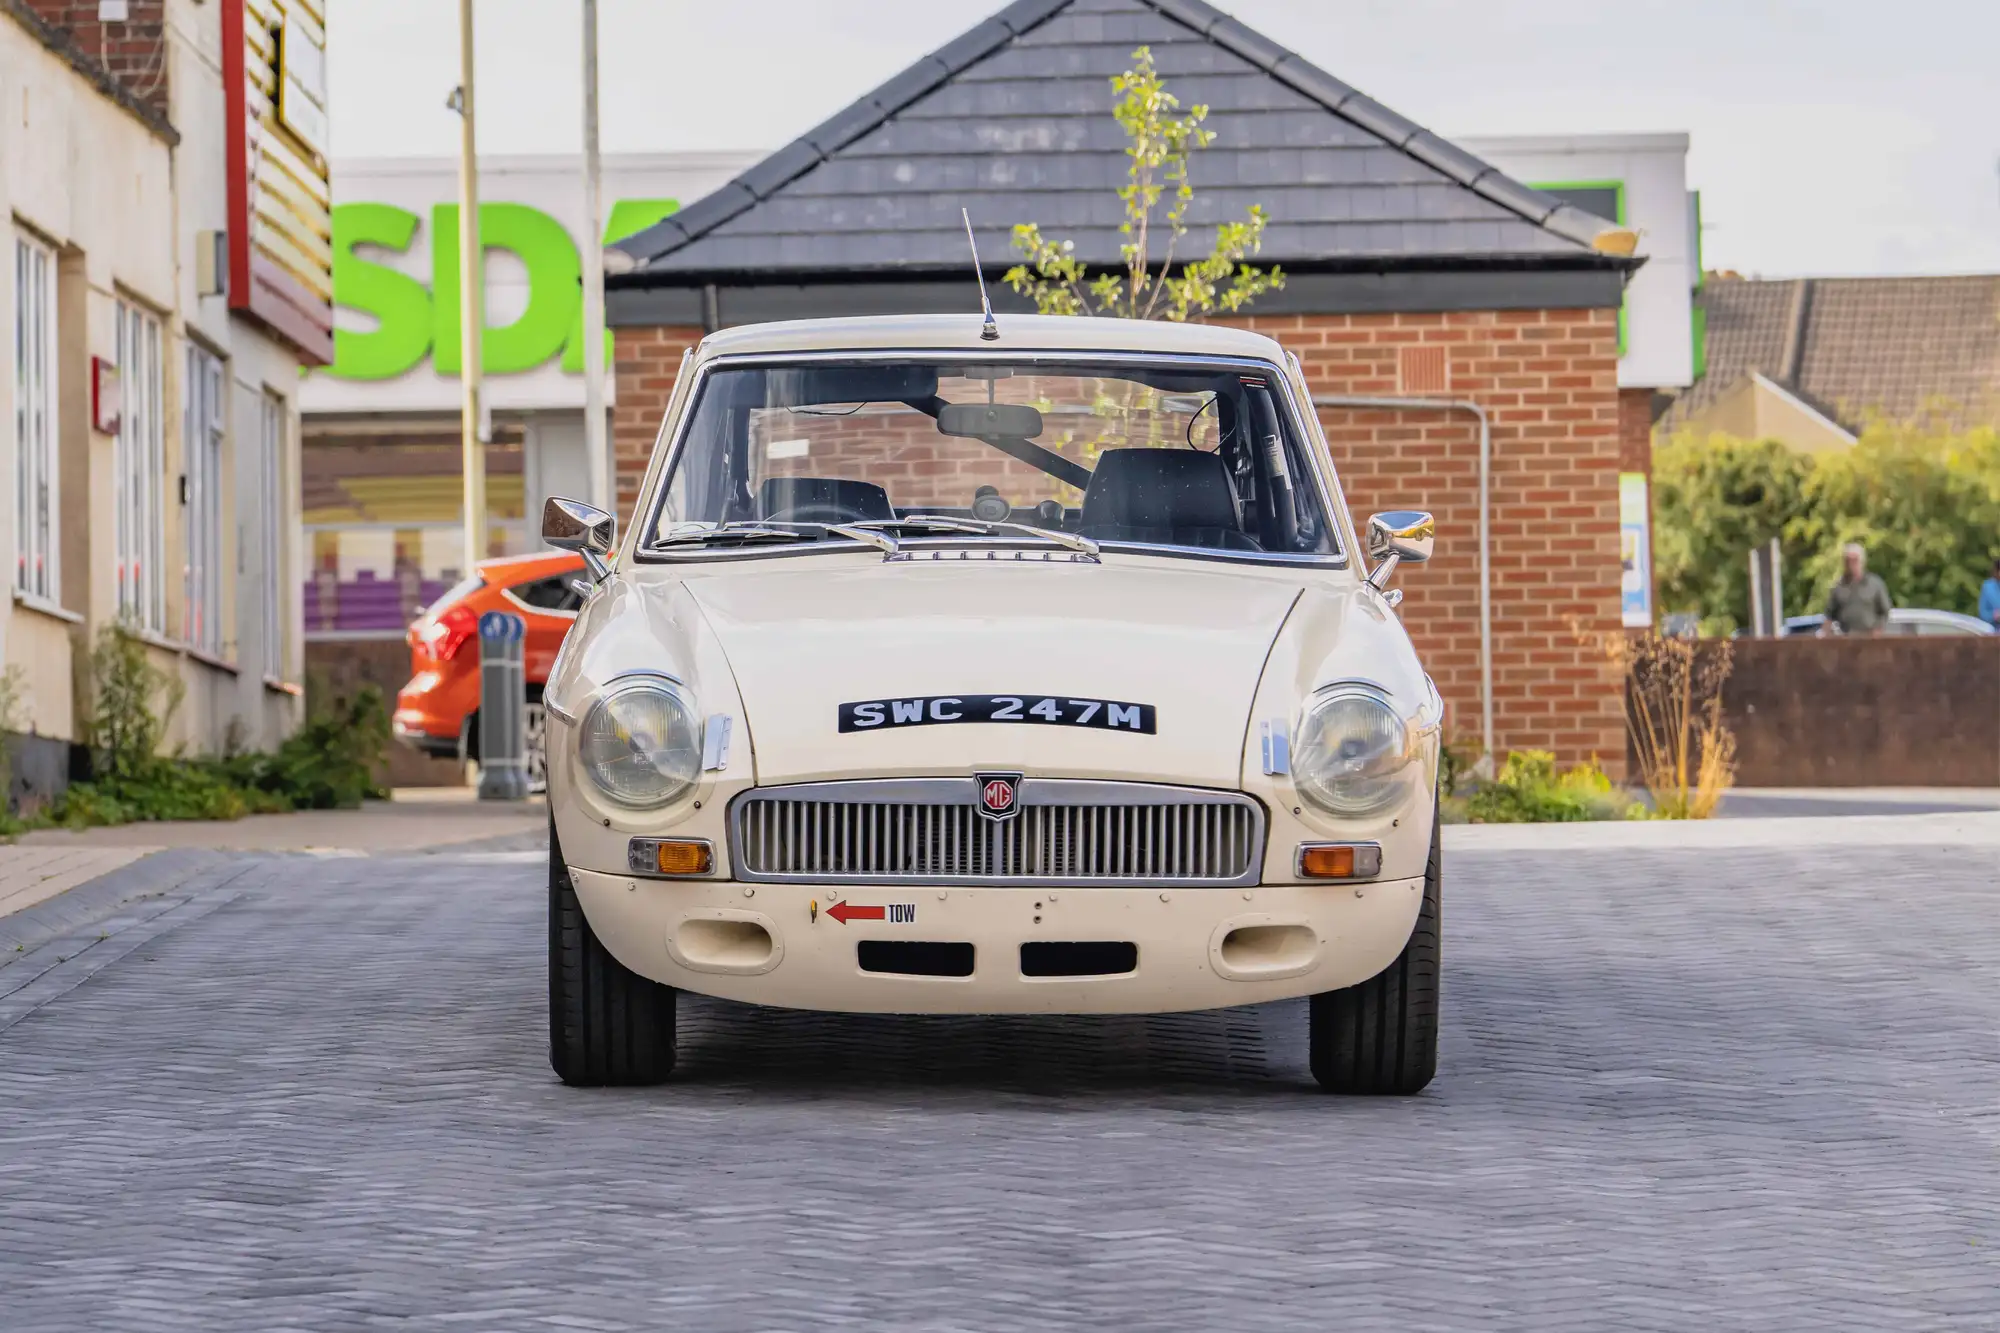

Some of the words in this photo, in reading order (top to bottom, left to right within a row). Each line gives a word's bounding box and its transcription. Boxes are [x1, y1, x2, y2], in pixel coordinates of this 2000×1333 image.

[298, 198, 681, 380] SD
[853, 698, 963, 727] SWC
[990, 697, 1141, 730] 247M
[986, 783, 1011, 807] MG
[888, 904, 916, 923] TOW
